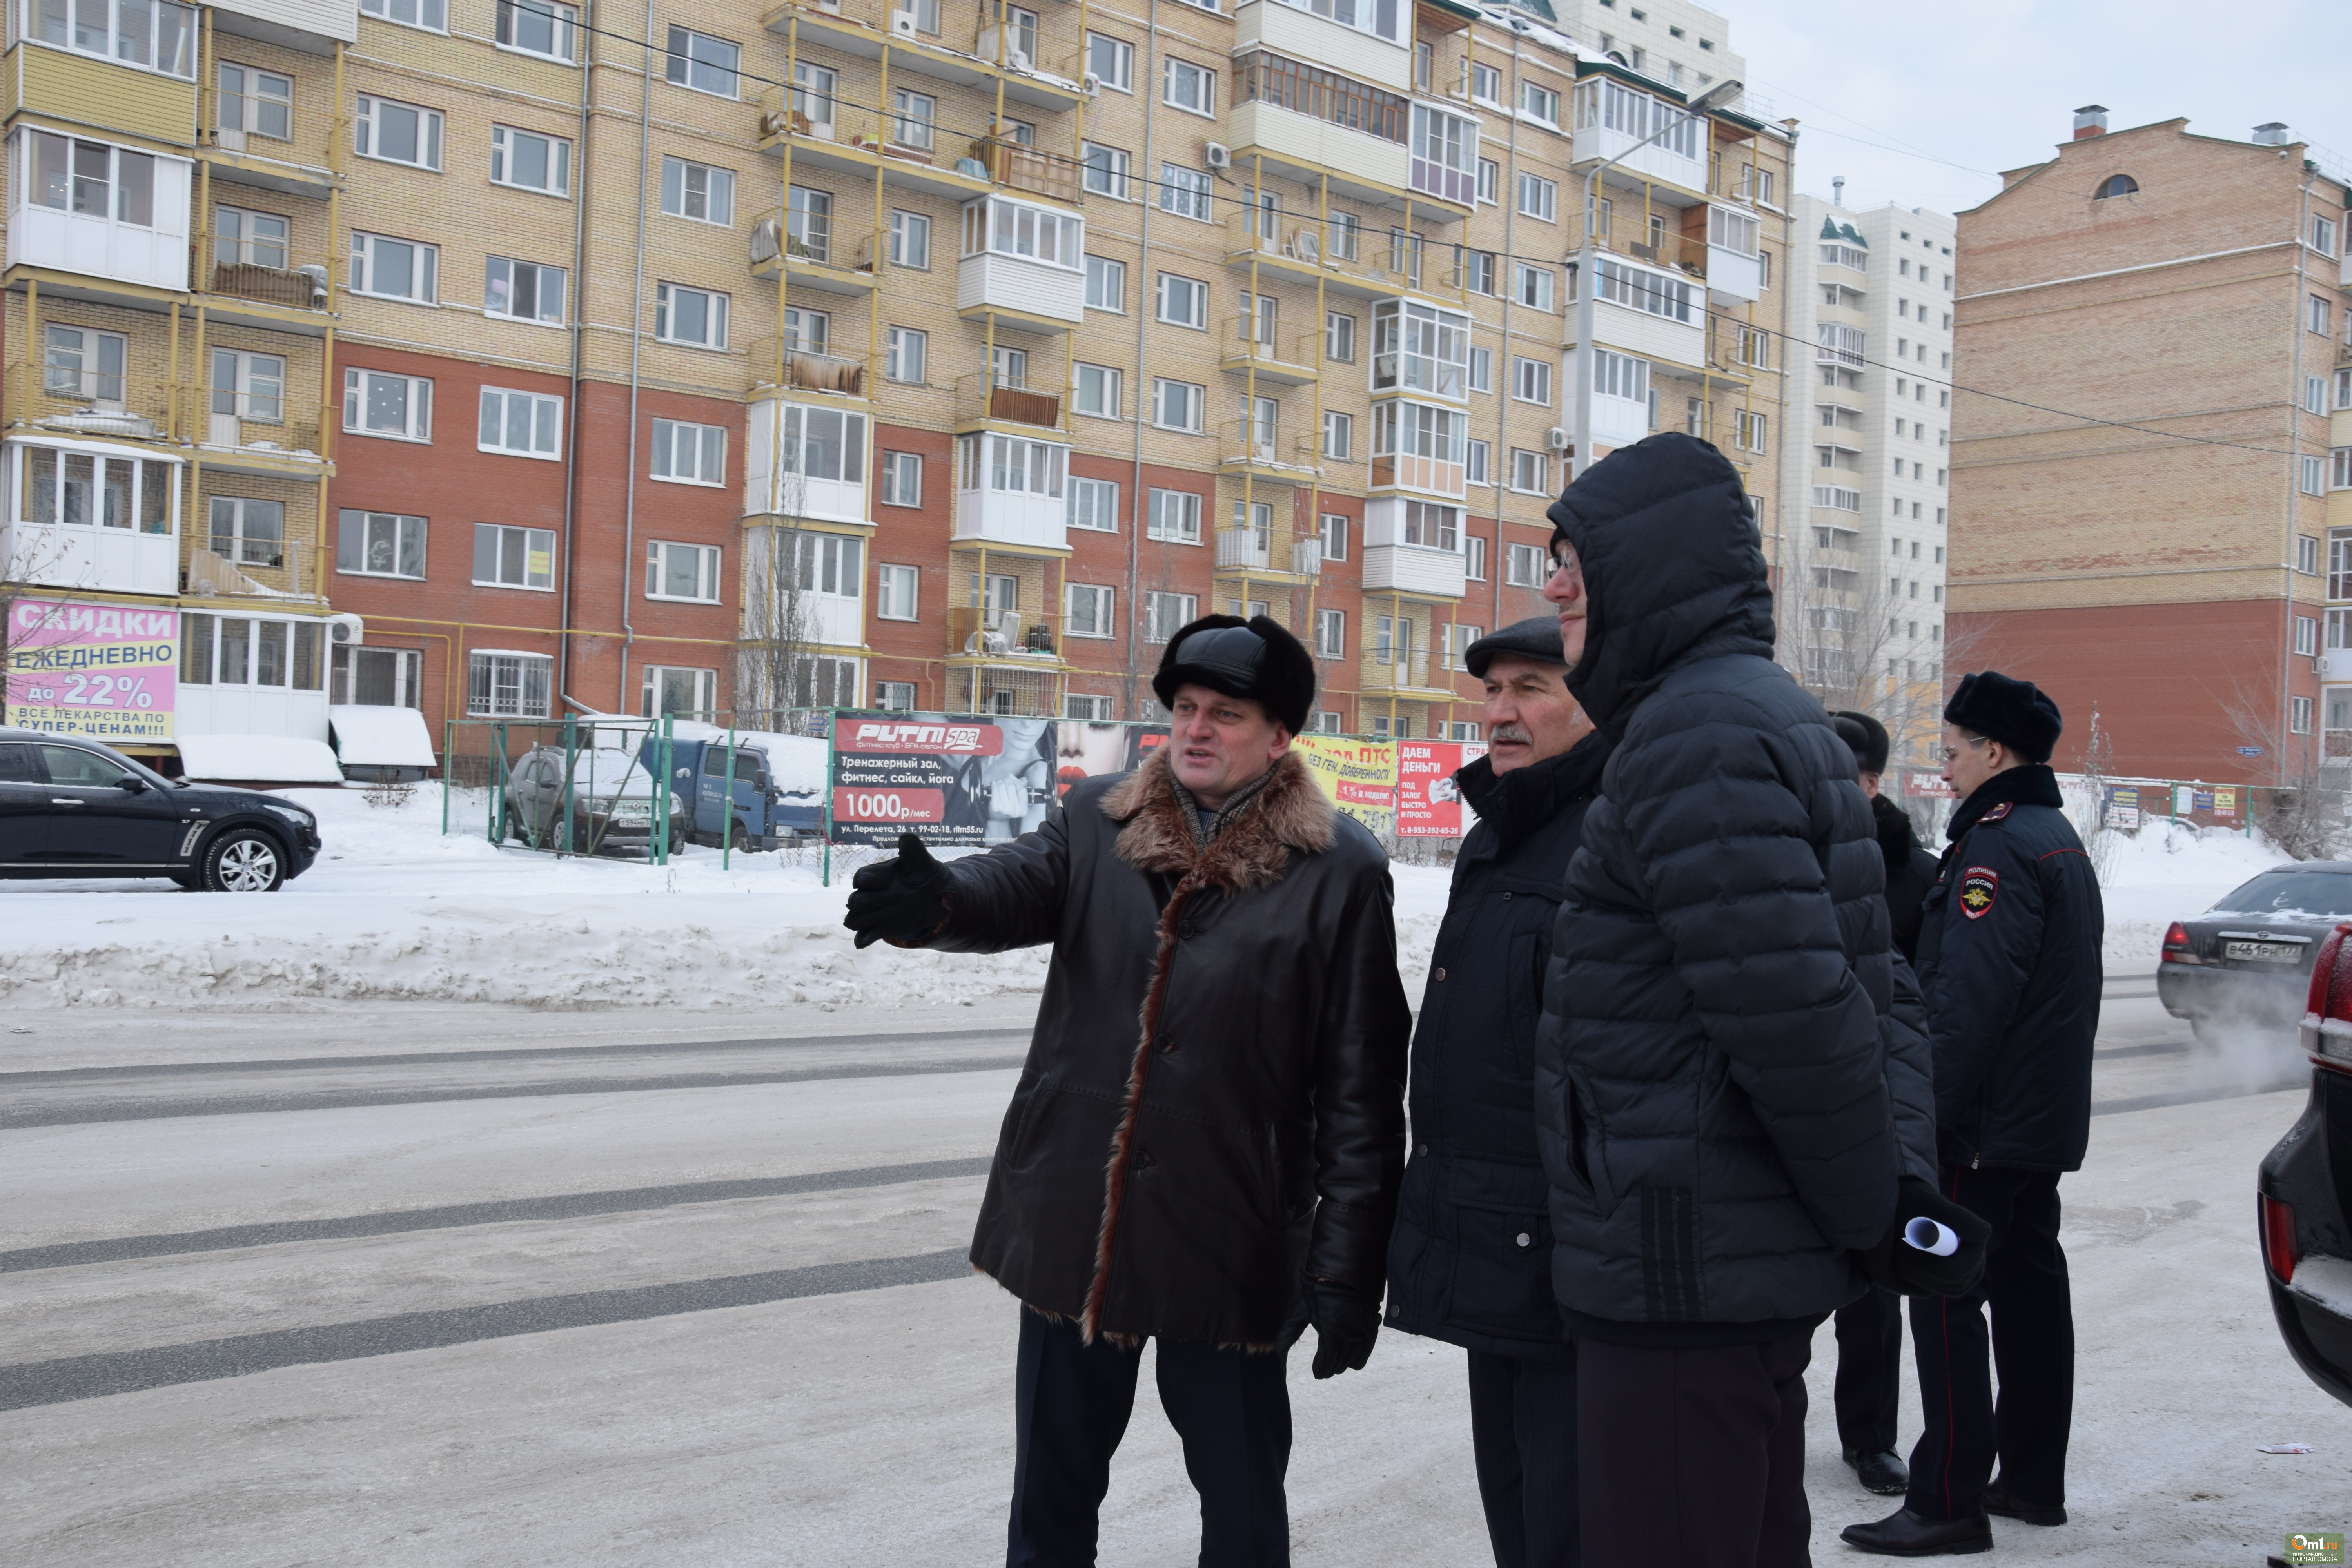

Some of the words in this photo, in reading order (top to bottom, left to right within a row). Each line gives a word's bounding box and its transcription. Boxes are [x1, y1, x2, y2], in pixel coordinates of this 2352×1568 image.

[17, 604, 171, 639] СКИДКИ
[16, 645, 172, 669] ЕЖЕДНЕВНО
[62, 673, 153, 709] 22%
[19, 708, 48, 718] ВСЕ
[54, 710, 140, 722] ЛЕКАРСТВА
[145, 714, 164, 722] ПО
[19, 720, 164, 735] СУПЕР-ЦЕНАМ!!!
[1402, 747, 1431, 760] ДАЕМ
[841, 756, 918, 769] Тренажерный
[920, 760, 941, 770] зал,
[1308, 753, 1321, 767] БЕЗ
[1322, 759, 1338, 773] ГЕН.
[1338, 764, 1390, 780] ДОВЕРЕННОСТИ
[1402, 761, 1441, 774] ДЕНЬГИ
[842, 771, 887, 784] фитнес,
[891, 772, 926, 784] сайкл,
[929, 773, 954, 784] йога
[1402, 782, 1416, 790] ПОД
[1365, 791, 1389, 800] неделю
[854, 825, 895, 834] Перелета,
[919, 825, 951, 833] 99-02-18,
[1968, 867, 1996, 878] ПОЛИЦИЯ
[1966, 879, 1993, 890] РОССИЯ
[1966, 909, 1980, 919] МВД
